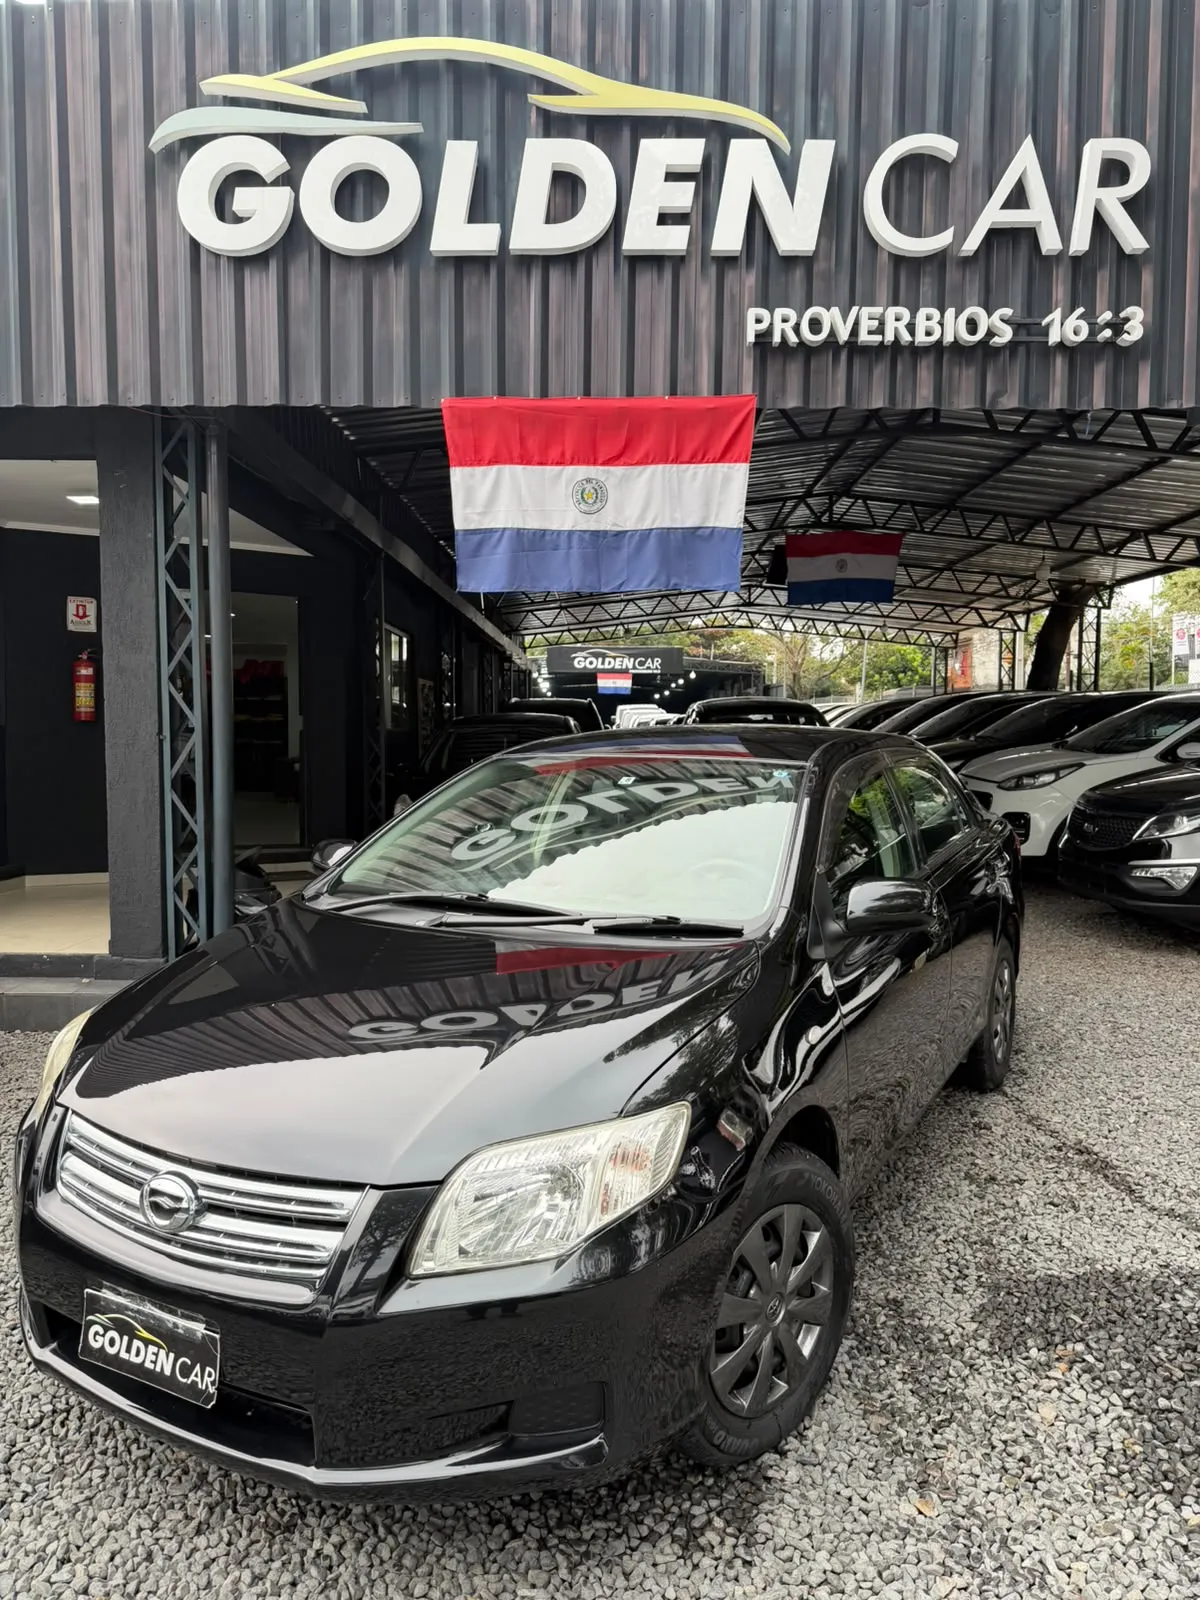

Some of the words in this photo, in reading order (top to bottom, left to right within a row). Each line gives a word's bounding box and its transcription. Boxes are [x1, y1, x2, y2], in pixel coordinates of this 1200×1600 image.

[177, 135, 835, 257] GOLDEN
[863, 133, 1151, 257] CAR
[746, 305, 1014, 347] PROVERBIOS
[1041, 305, 1144, 347] 16:3
[573, 657, 634, 669] GOLDEN
[635, 657, 661, 669] CAR
[88, 1324, 175, 1376] GOLDEN
[175, 1357, 216, 1393] CAR
